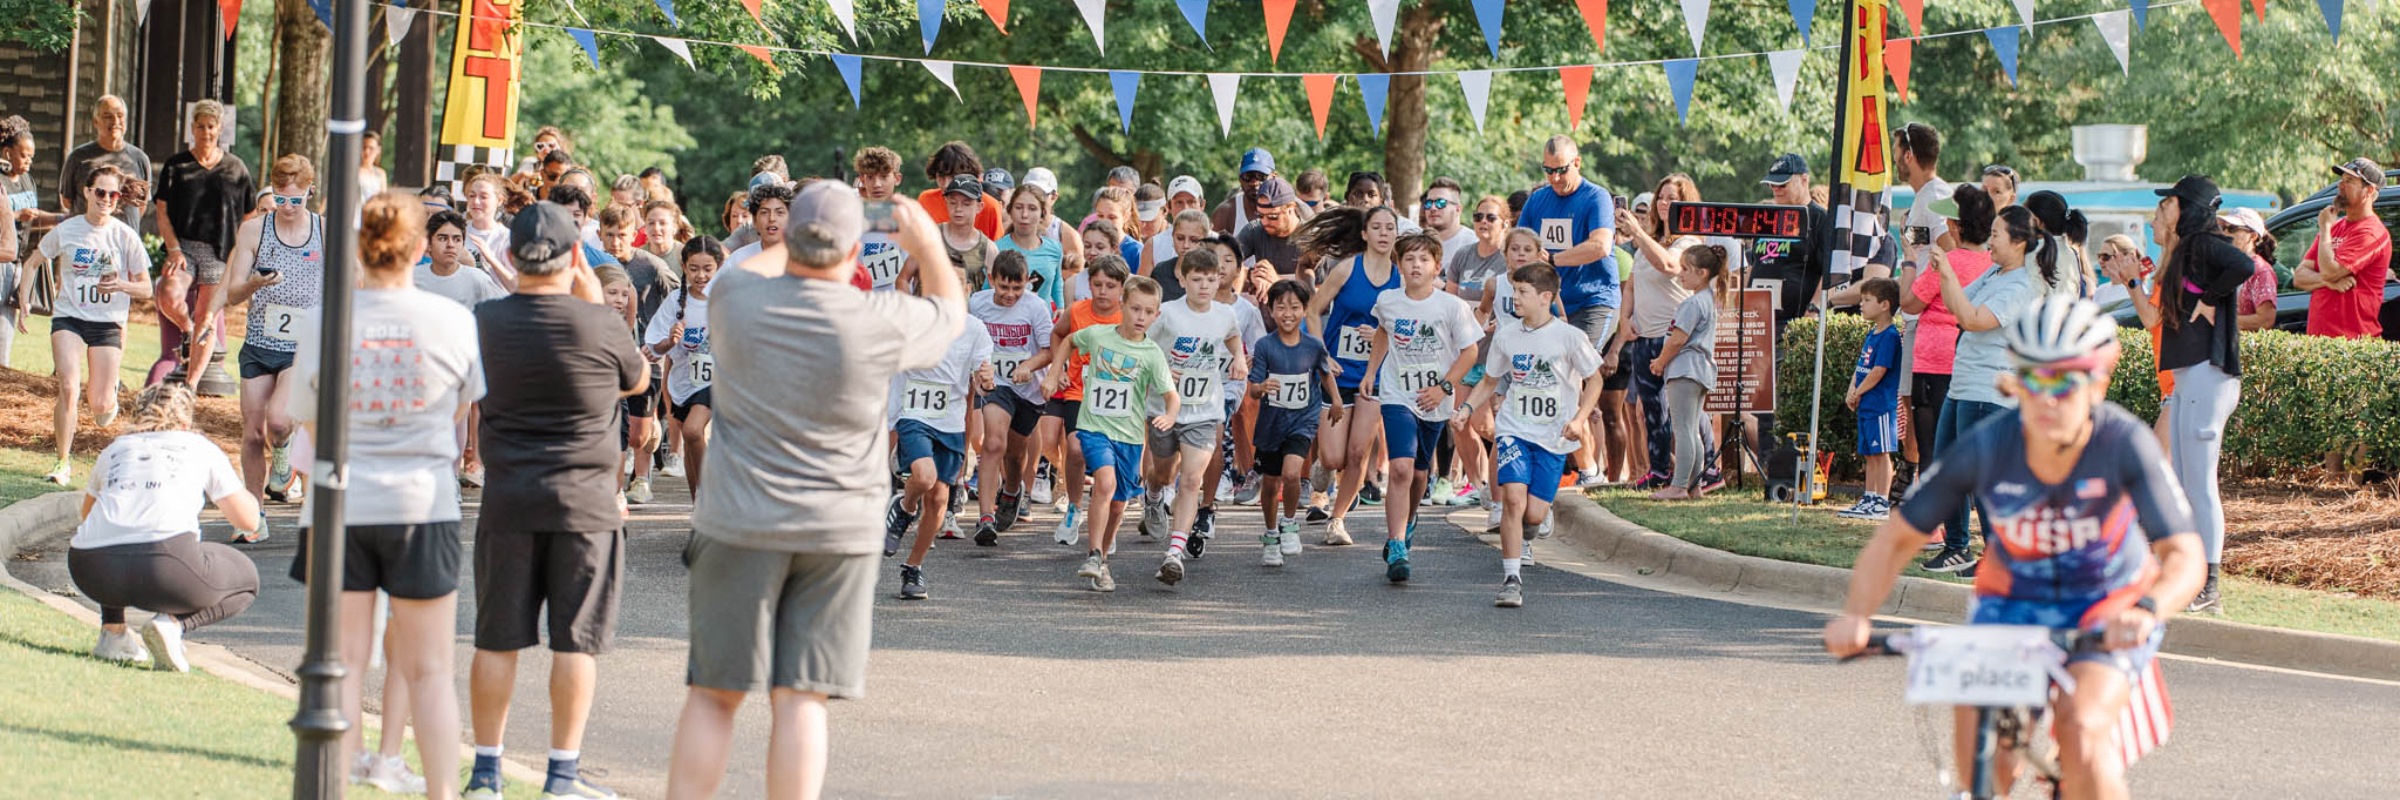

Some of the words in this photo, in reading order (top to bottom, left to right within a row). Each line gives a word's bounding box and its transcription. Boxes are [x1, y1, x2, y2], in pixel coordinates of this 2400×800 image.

[1679, 207, 1799, 236] 00:01:48
[1547, 225, 1565, 244] 40
[868, 255, 899, 280] 117
[279, 313, 291, 333] 2
[691, 360, 712, 381] 15
[994, 359, 1027, 379] 12
[1184, 376, 1209, 398] 07
[1400, 370, 1438, 391] 118
[907, 388, 947, 411] 113
[1093, 386, 1128, 410] 121
[1518, 396, 1557, 417] 108
[1960, 664, 2032, 691] place
